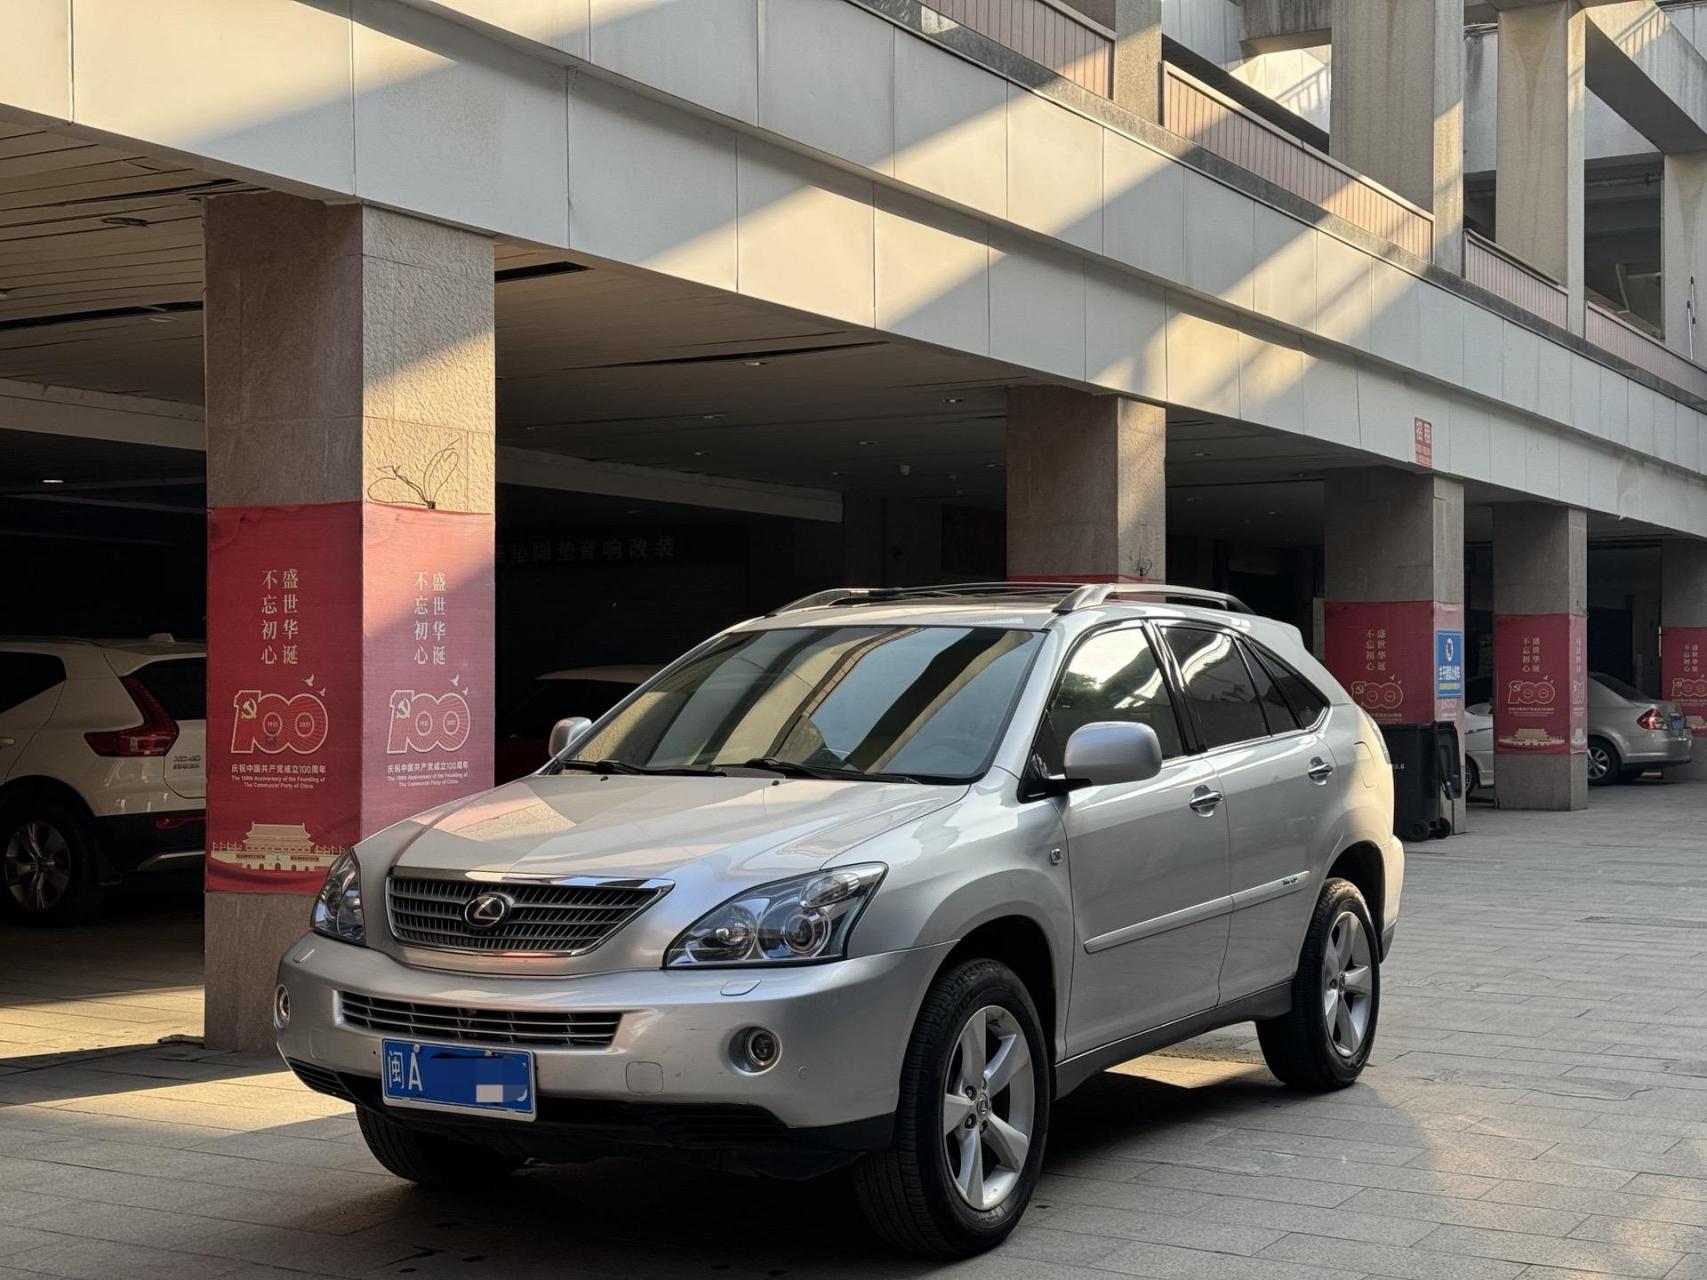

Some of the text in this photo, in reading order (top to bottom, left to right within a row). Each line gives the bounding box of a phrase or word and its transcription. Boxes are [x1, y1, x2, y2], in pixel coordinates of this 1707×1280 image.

[261, 569, 278, 665] 不忘初心
[282, 568, 299, 665] 盛世华诞
[413, 571, 428, 665] 不忘初心
[432, 571, 446, 665] 盛世华诞
[230, 689, 329, 754] 100
[231, 763, 327, 774] 庆祝中国共产党成立100周年
[387, 689, 471, 754] 100
